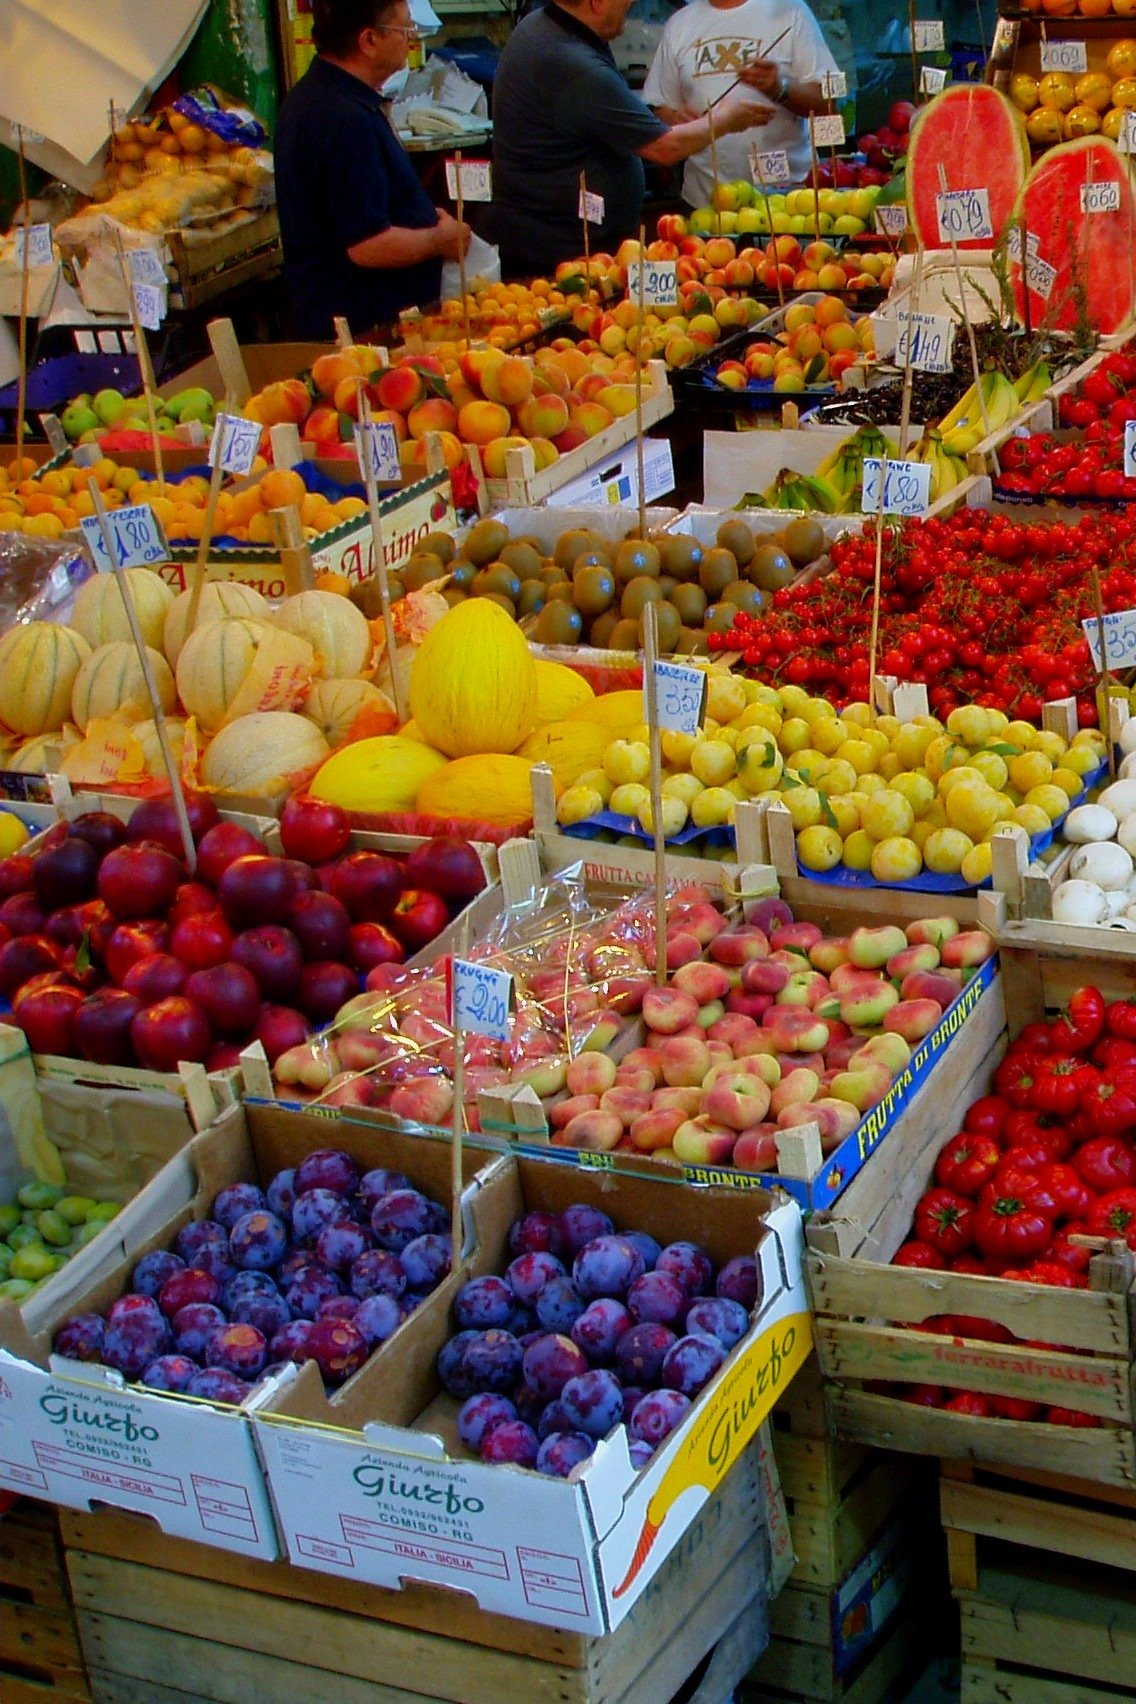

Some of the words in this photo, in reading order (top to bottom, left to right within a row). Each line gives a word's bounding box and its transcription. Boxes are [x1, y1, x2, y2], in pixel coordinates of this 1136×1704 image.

[584, 862, 632, 884] FRUTTA
[856, 1068, 914, 1161] FRUTTA
[914, 1047, 931, 1072] DI
[931, 978, 985, 1051] BRONTE
[66, 1439, 120, 1459] COMISO
[82, 1469, 113, 1484] ITALIA
[379, 1512, 438, 1534] COMISO
[452, 1529, 474, 1542] RG
[394, 1543, 428, 1560] ITALIA
[435, 1553, 475, 1570] SICILIA
